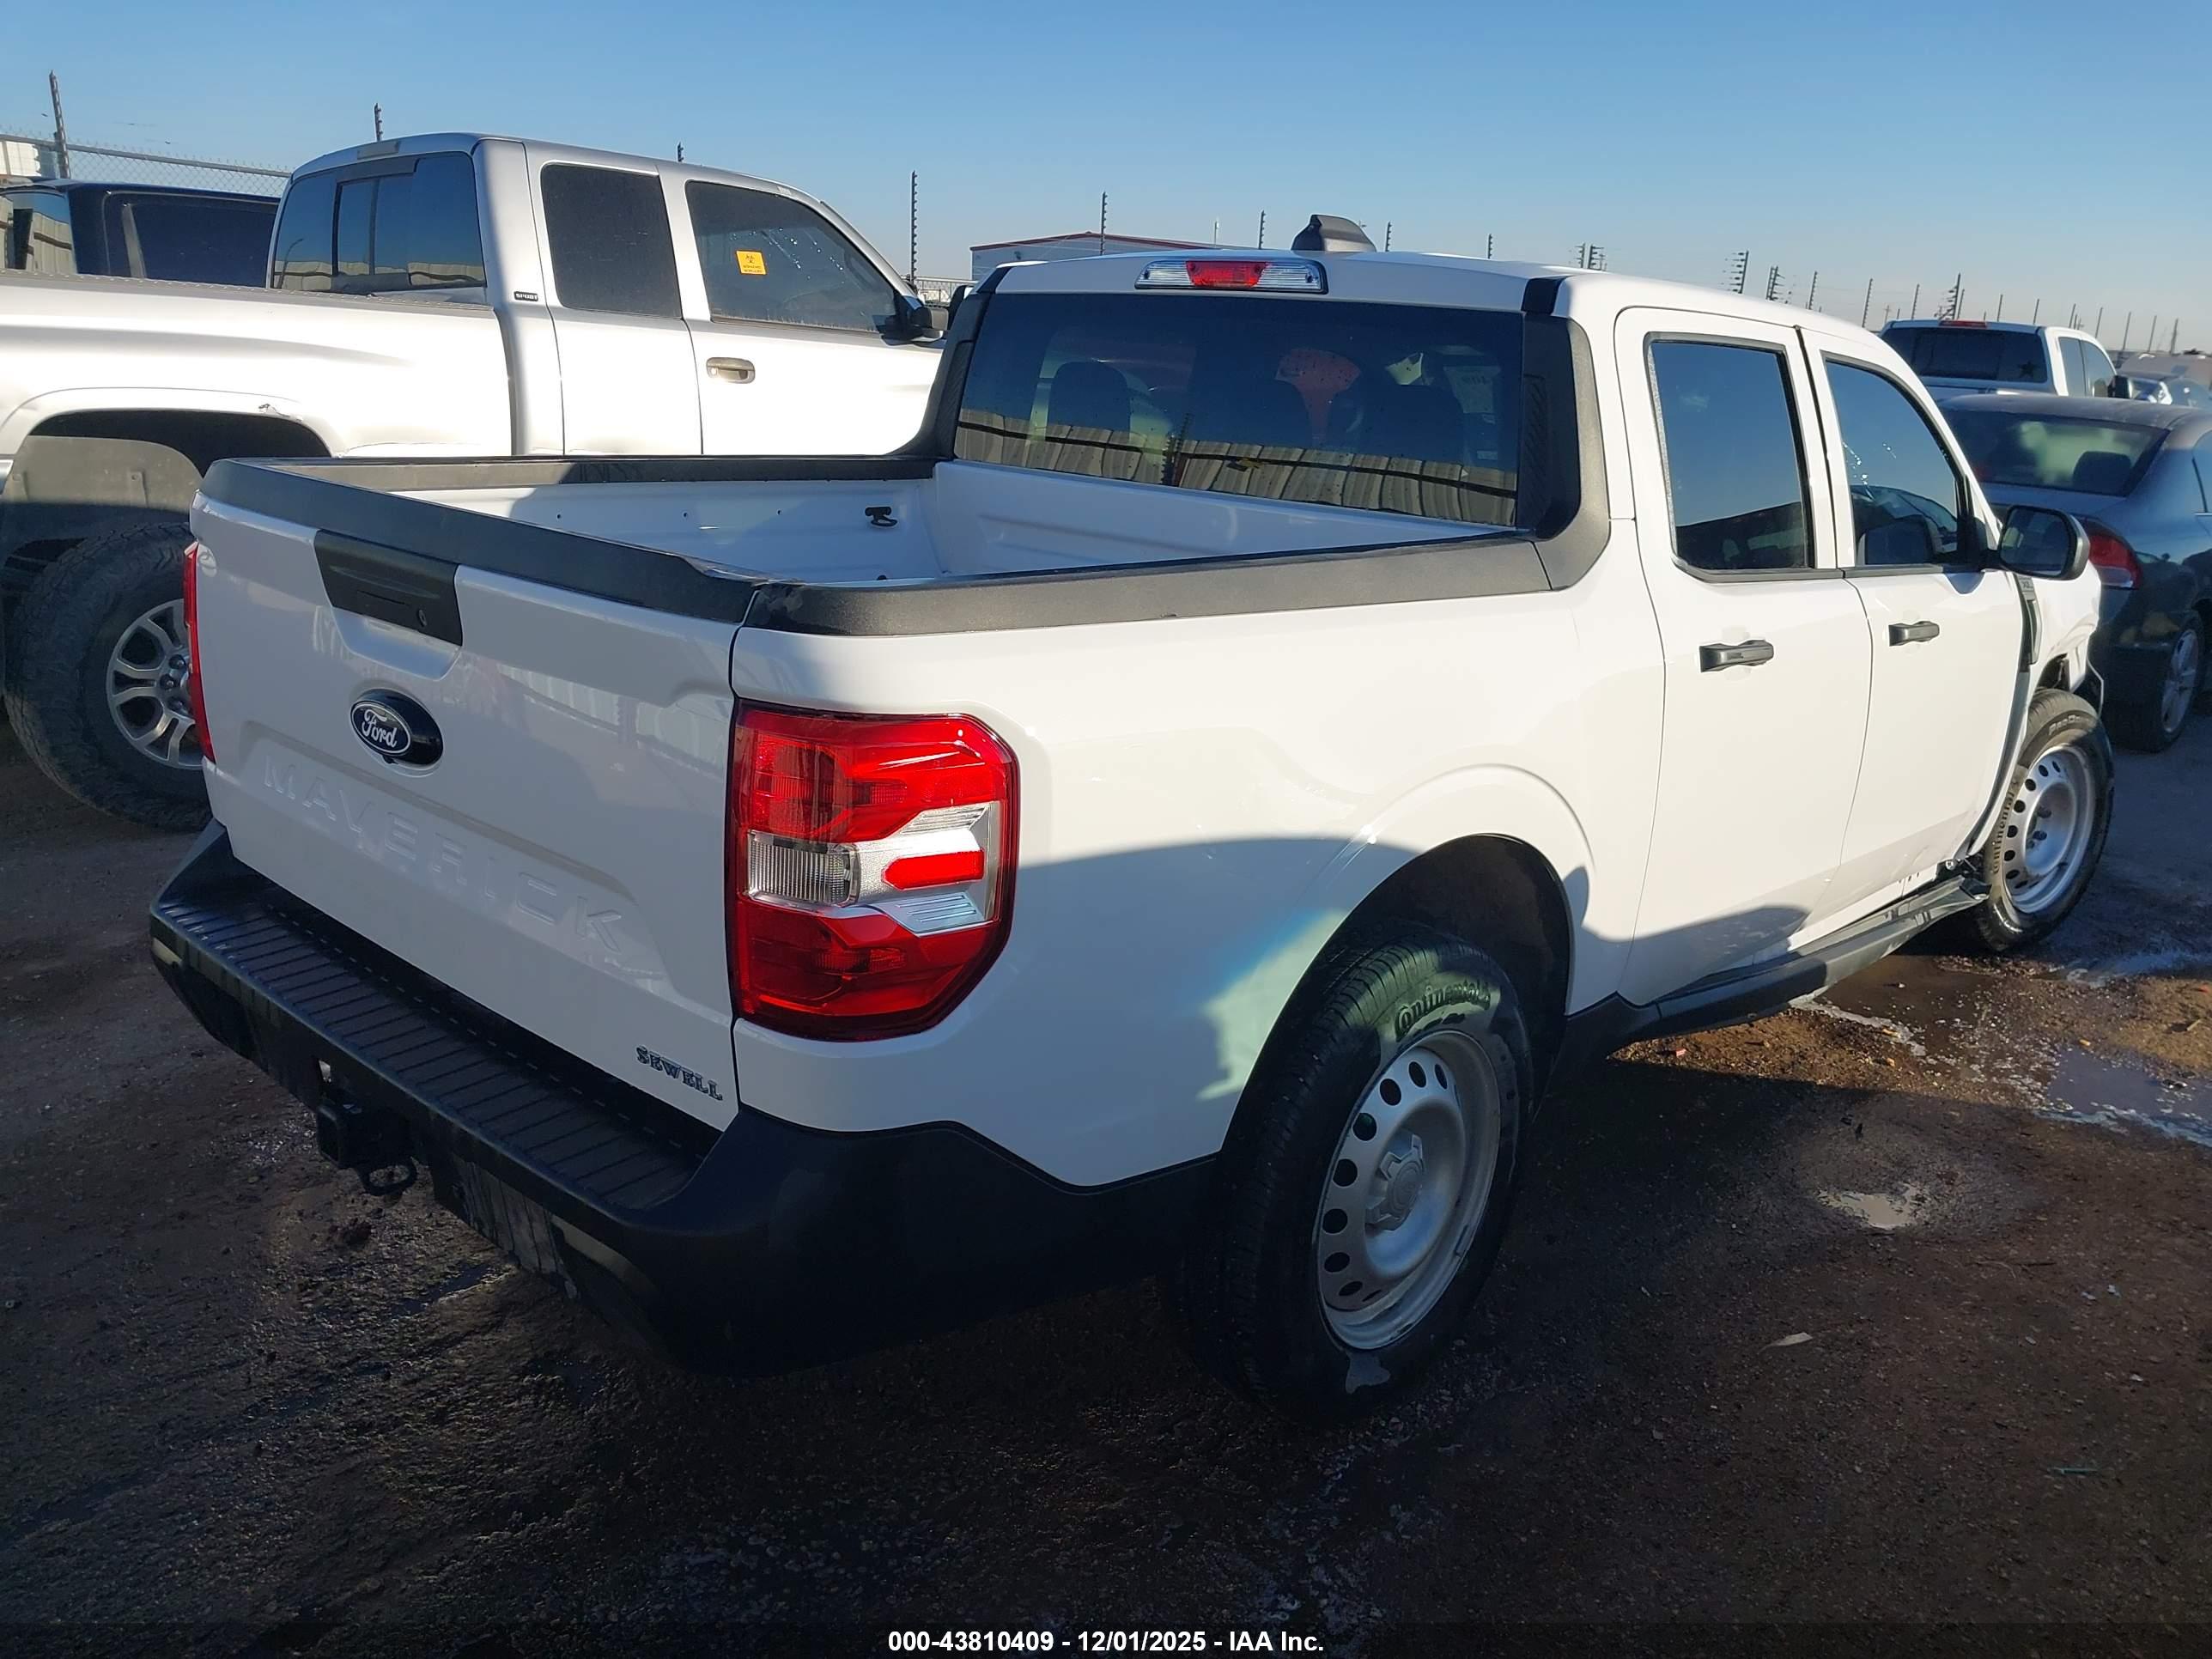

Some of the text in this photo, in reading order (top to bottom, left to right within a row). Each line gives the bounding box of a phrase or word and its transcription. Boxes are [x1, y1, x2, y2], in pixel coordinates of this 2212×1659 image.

[515, 292, 538, 301] SPORT
[362, 708, 398, 748] Ford
[263, 754, 624, 954] MAVERICK
[635, 1045, 724, 1101] SEWELL
